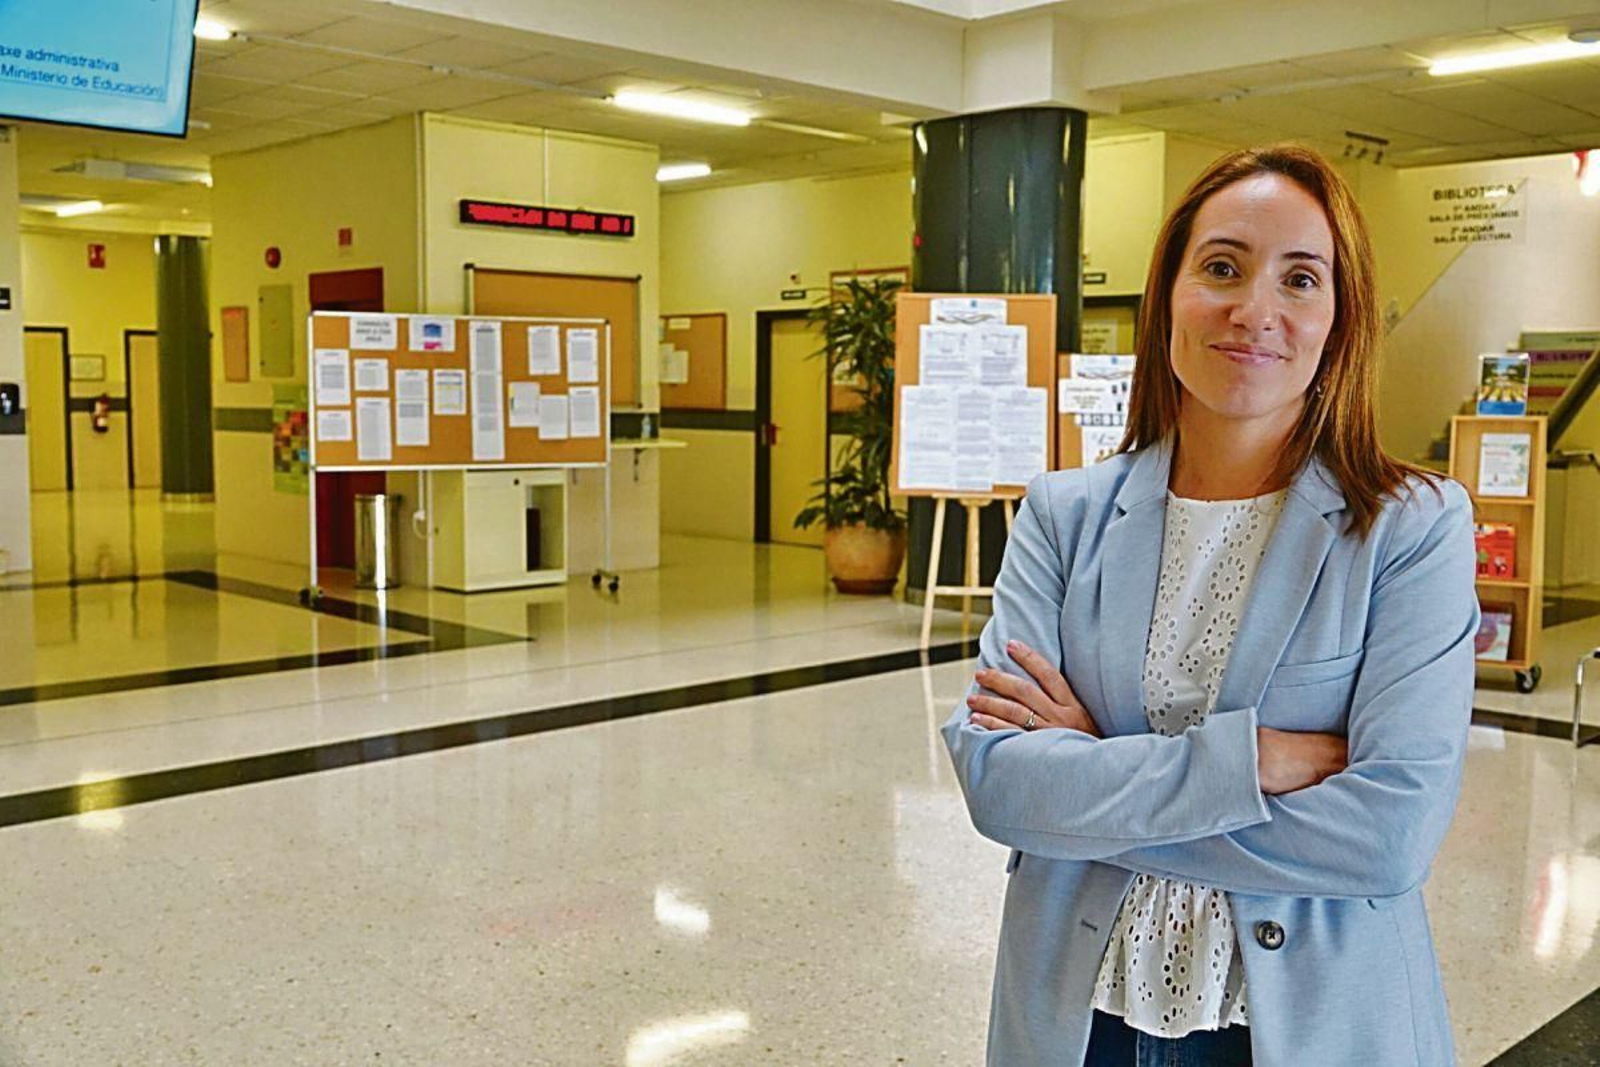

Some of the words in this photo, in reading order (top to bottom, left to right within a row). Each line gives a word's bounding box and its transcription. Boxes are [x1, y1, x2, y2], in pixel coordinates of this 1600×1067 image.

[25, 49, 120, 72] administrativa
[1, 64, 67, 85] Ministerio
[71, 76, 89, 88] de
[1453, 213, 1463, 221] DE
